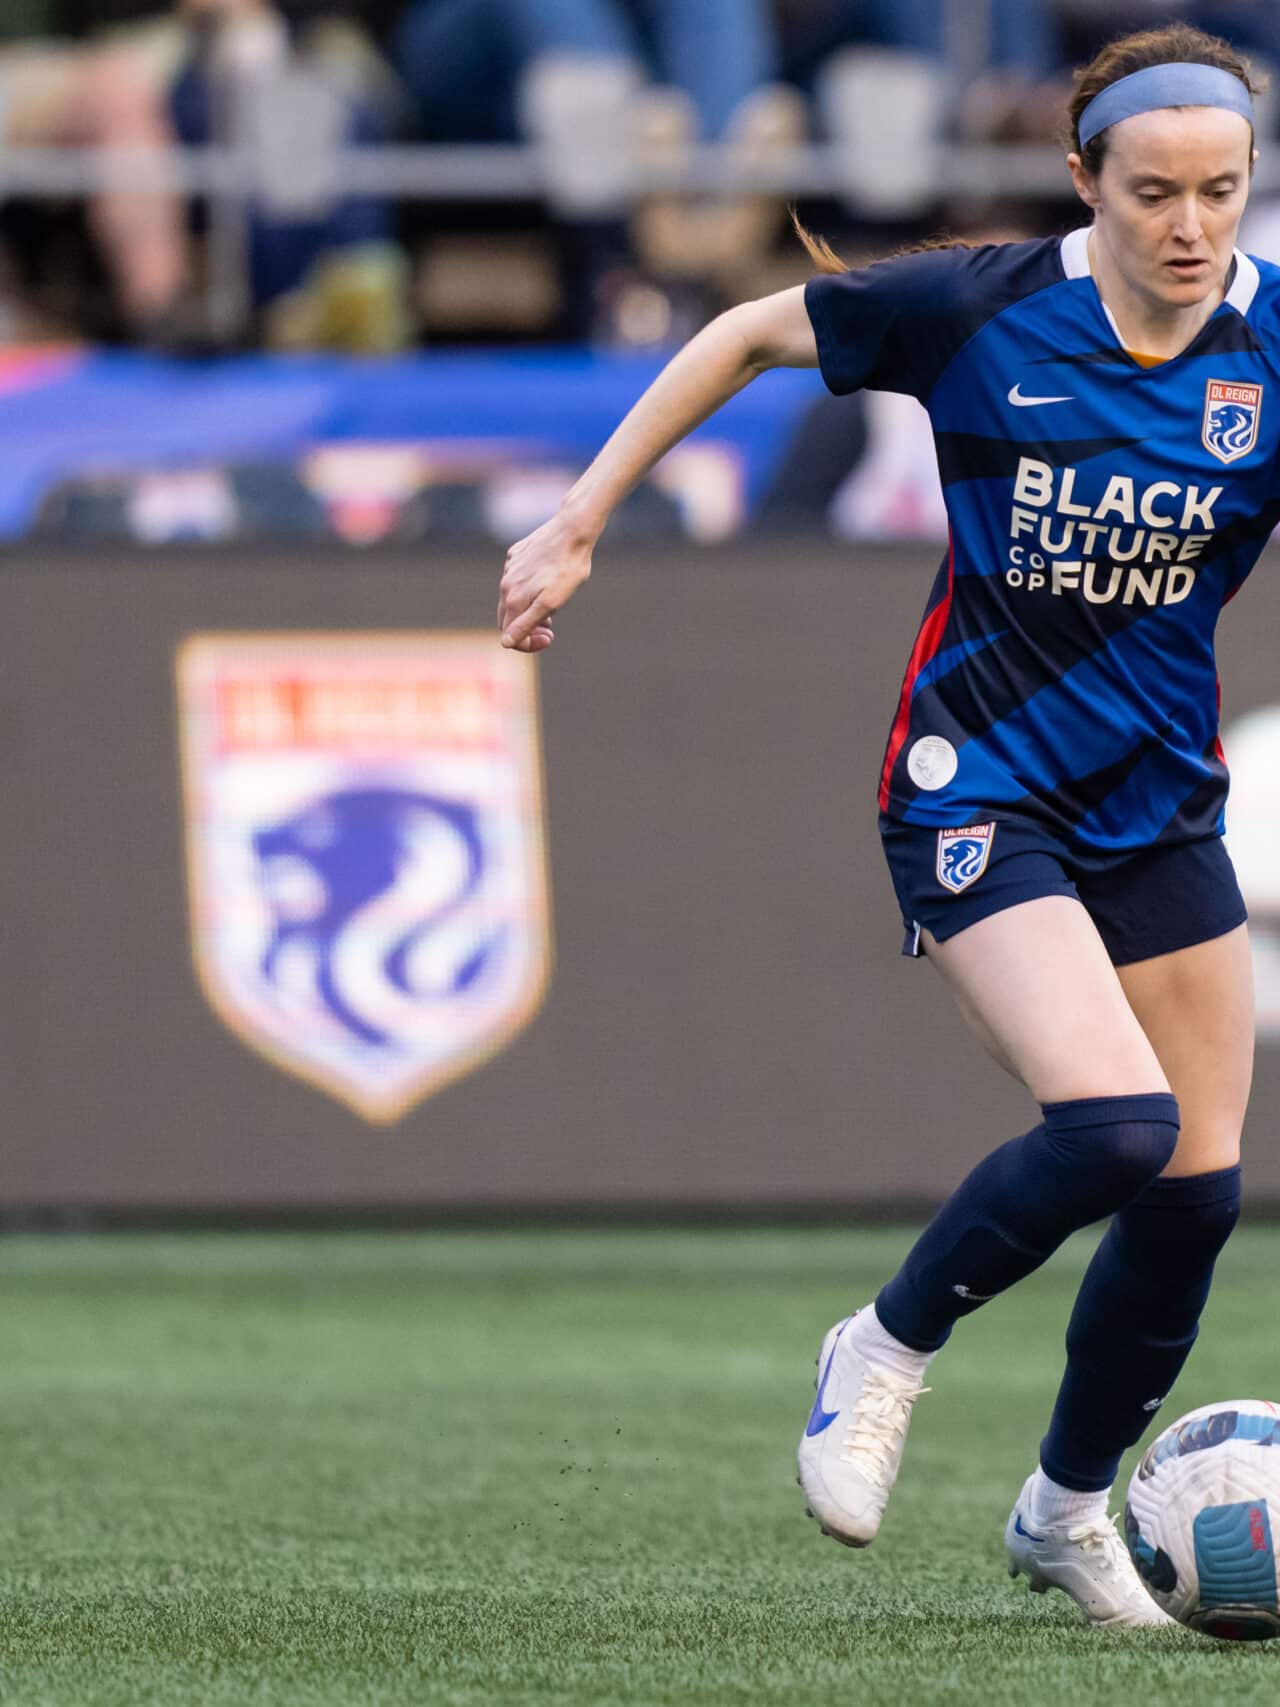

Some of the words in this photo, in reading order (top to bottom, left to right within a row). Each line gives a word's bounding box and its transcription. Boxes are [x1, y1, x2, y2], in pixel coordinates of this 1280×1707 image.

[1225, 387, 1258, 404] REIGN
[1013, 456, 1224, 530] BLACK
[1010, 505, 1213, 563] FUTURE
[1009, 546, 1045, 570] CO
[1006, 568, 1045, 592] OP
[1051, 560, 1196, 606] FUND
